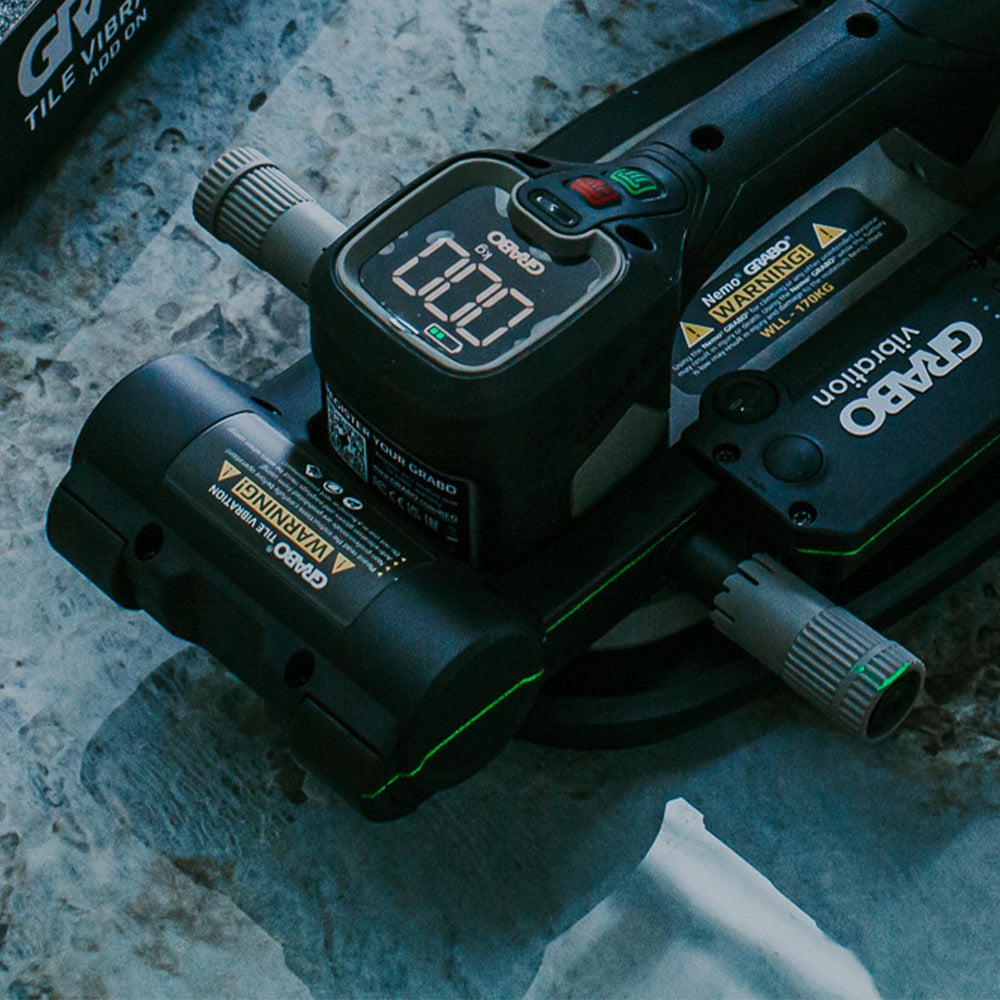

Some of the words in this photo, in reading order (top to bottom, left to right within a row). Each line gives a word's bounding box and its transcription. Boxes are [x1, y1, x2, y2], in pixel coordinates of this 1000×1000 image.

[89, 41, 121, 84] ADD
[124, 8, 147, 39] ON
[24, 64, 76, 131] TILE
[474, 243, 493, 262] kg
[486, 230, 546, 276] GRABO
[713, 246, 811, 321] WARNING!
[759, 316, 791, 339] WLL
[795, 281, 835, 313] 170KG
[811, 326, 920, 407] vibration
[839, 321, 983, 436] GRABO
[373, 435, 406, 466] YOUR
[409, 462, 457, 495] GRABO
[208, 484, 258, 528] VIBRATION
[238, 479, 329, 561] WARNING!
[256, 523, 277, 544] TILE
